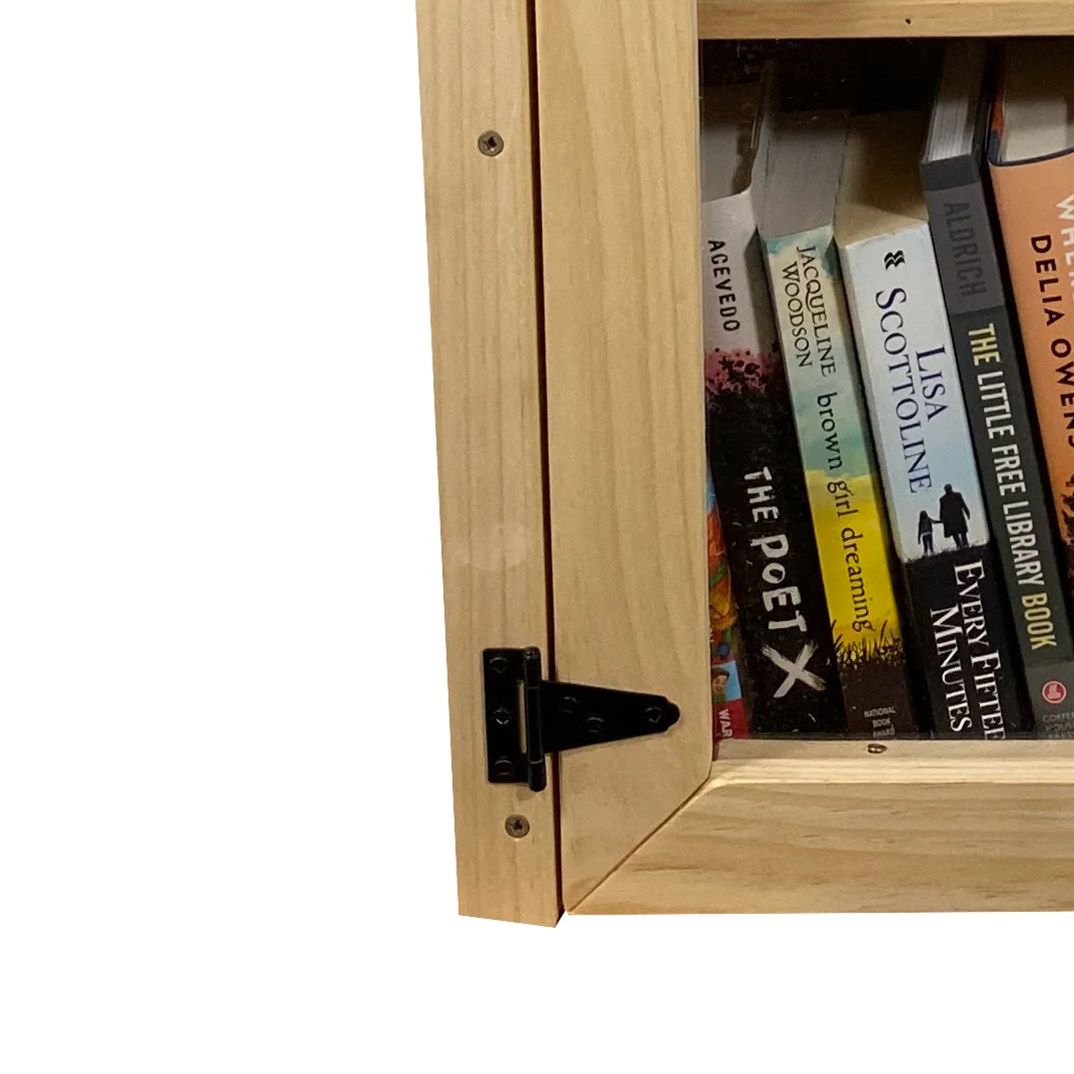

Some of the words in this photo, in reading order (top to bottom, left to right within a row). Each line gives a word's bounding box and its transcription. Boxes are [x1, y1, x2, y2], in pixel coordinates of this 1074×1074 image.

[708, 239, 741, 332] ACEVEDO
[943, 201, 986, 297] ALDRICH
[1031, 234, 1065, 326] DELIA
[782, 260, 813, 368] WOODSON
[796, 245, 837, 377] JACQUELINE
[968, 322, 1000, 366] THE
[875, 287, 932, 494] SCOTTOLINE
[915, 343, 949, 422] LISA
[977, 371, 1015, 439] LITTLE
[817, 391, 843, 470] brown
[991, 443, 1027, 497] FREE
[744, 466, 780, 523] THE
[827, 479, 859, 518] girl
[750, 533, 808, 632] POET
[840, 526, 876, 633] dreaming
[1003, 501, 1045, 586] LIBRARY
[954, 558, 990, 651] EVERY
[1021, 592, 1057, 650] BOOK
[760, 639, 827, 699] X
[929, 604, 973, 732] MINUTES
